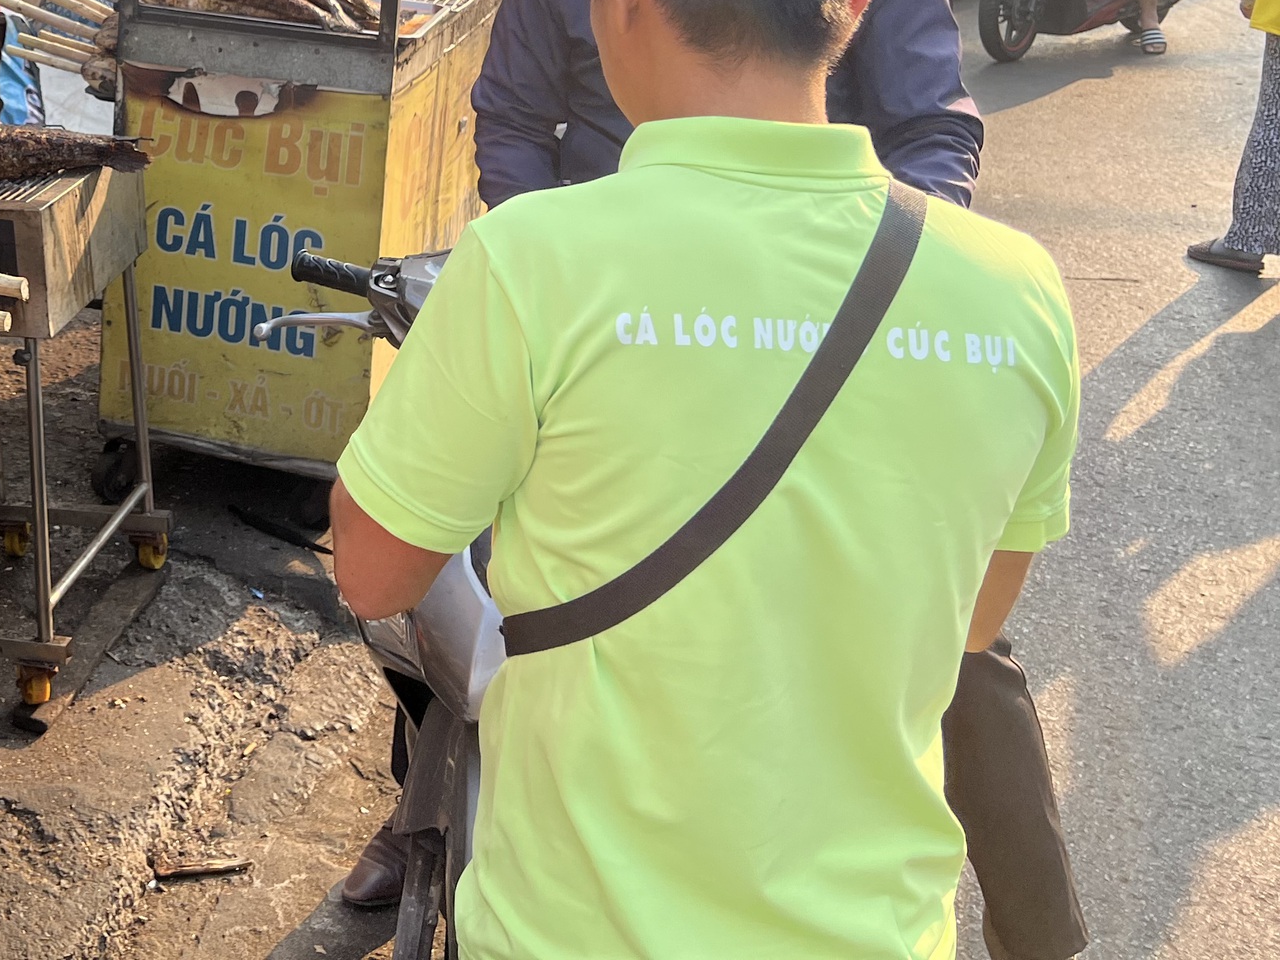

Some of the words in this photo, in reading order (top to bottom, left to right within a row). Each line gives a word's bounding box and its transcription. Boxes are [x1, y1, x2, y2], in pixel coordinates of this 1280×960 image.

[155, 203, 216, 259] CÁ
[231, 215, 324, 270] LÓC
[150, 285, 316, 358] NƯỚNG
[615, 305, 659, 346] CÁ
[673, 306, 738, 349] LÓC
[886, 321, 952, 362] CÚC
[964, 333, 1016, 374] BỤI
[226, 374, 271, 420] XẢ
